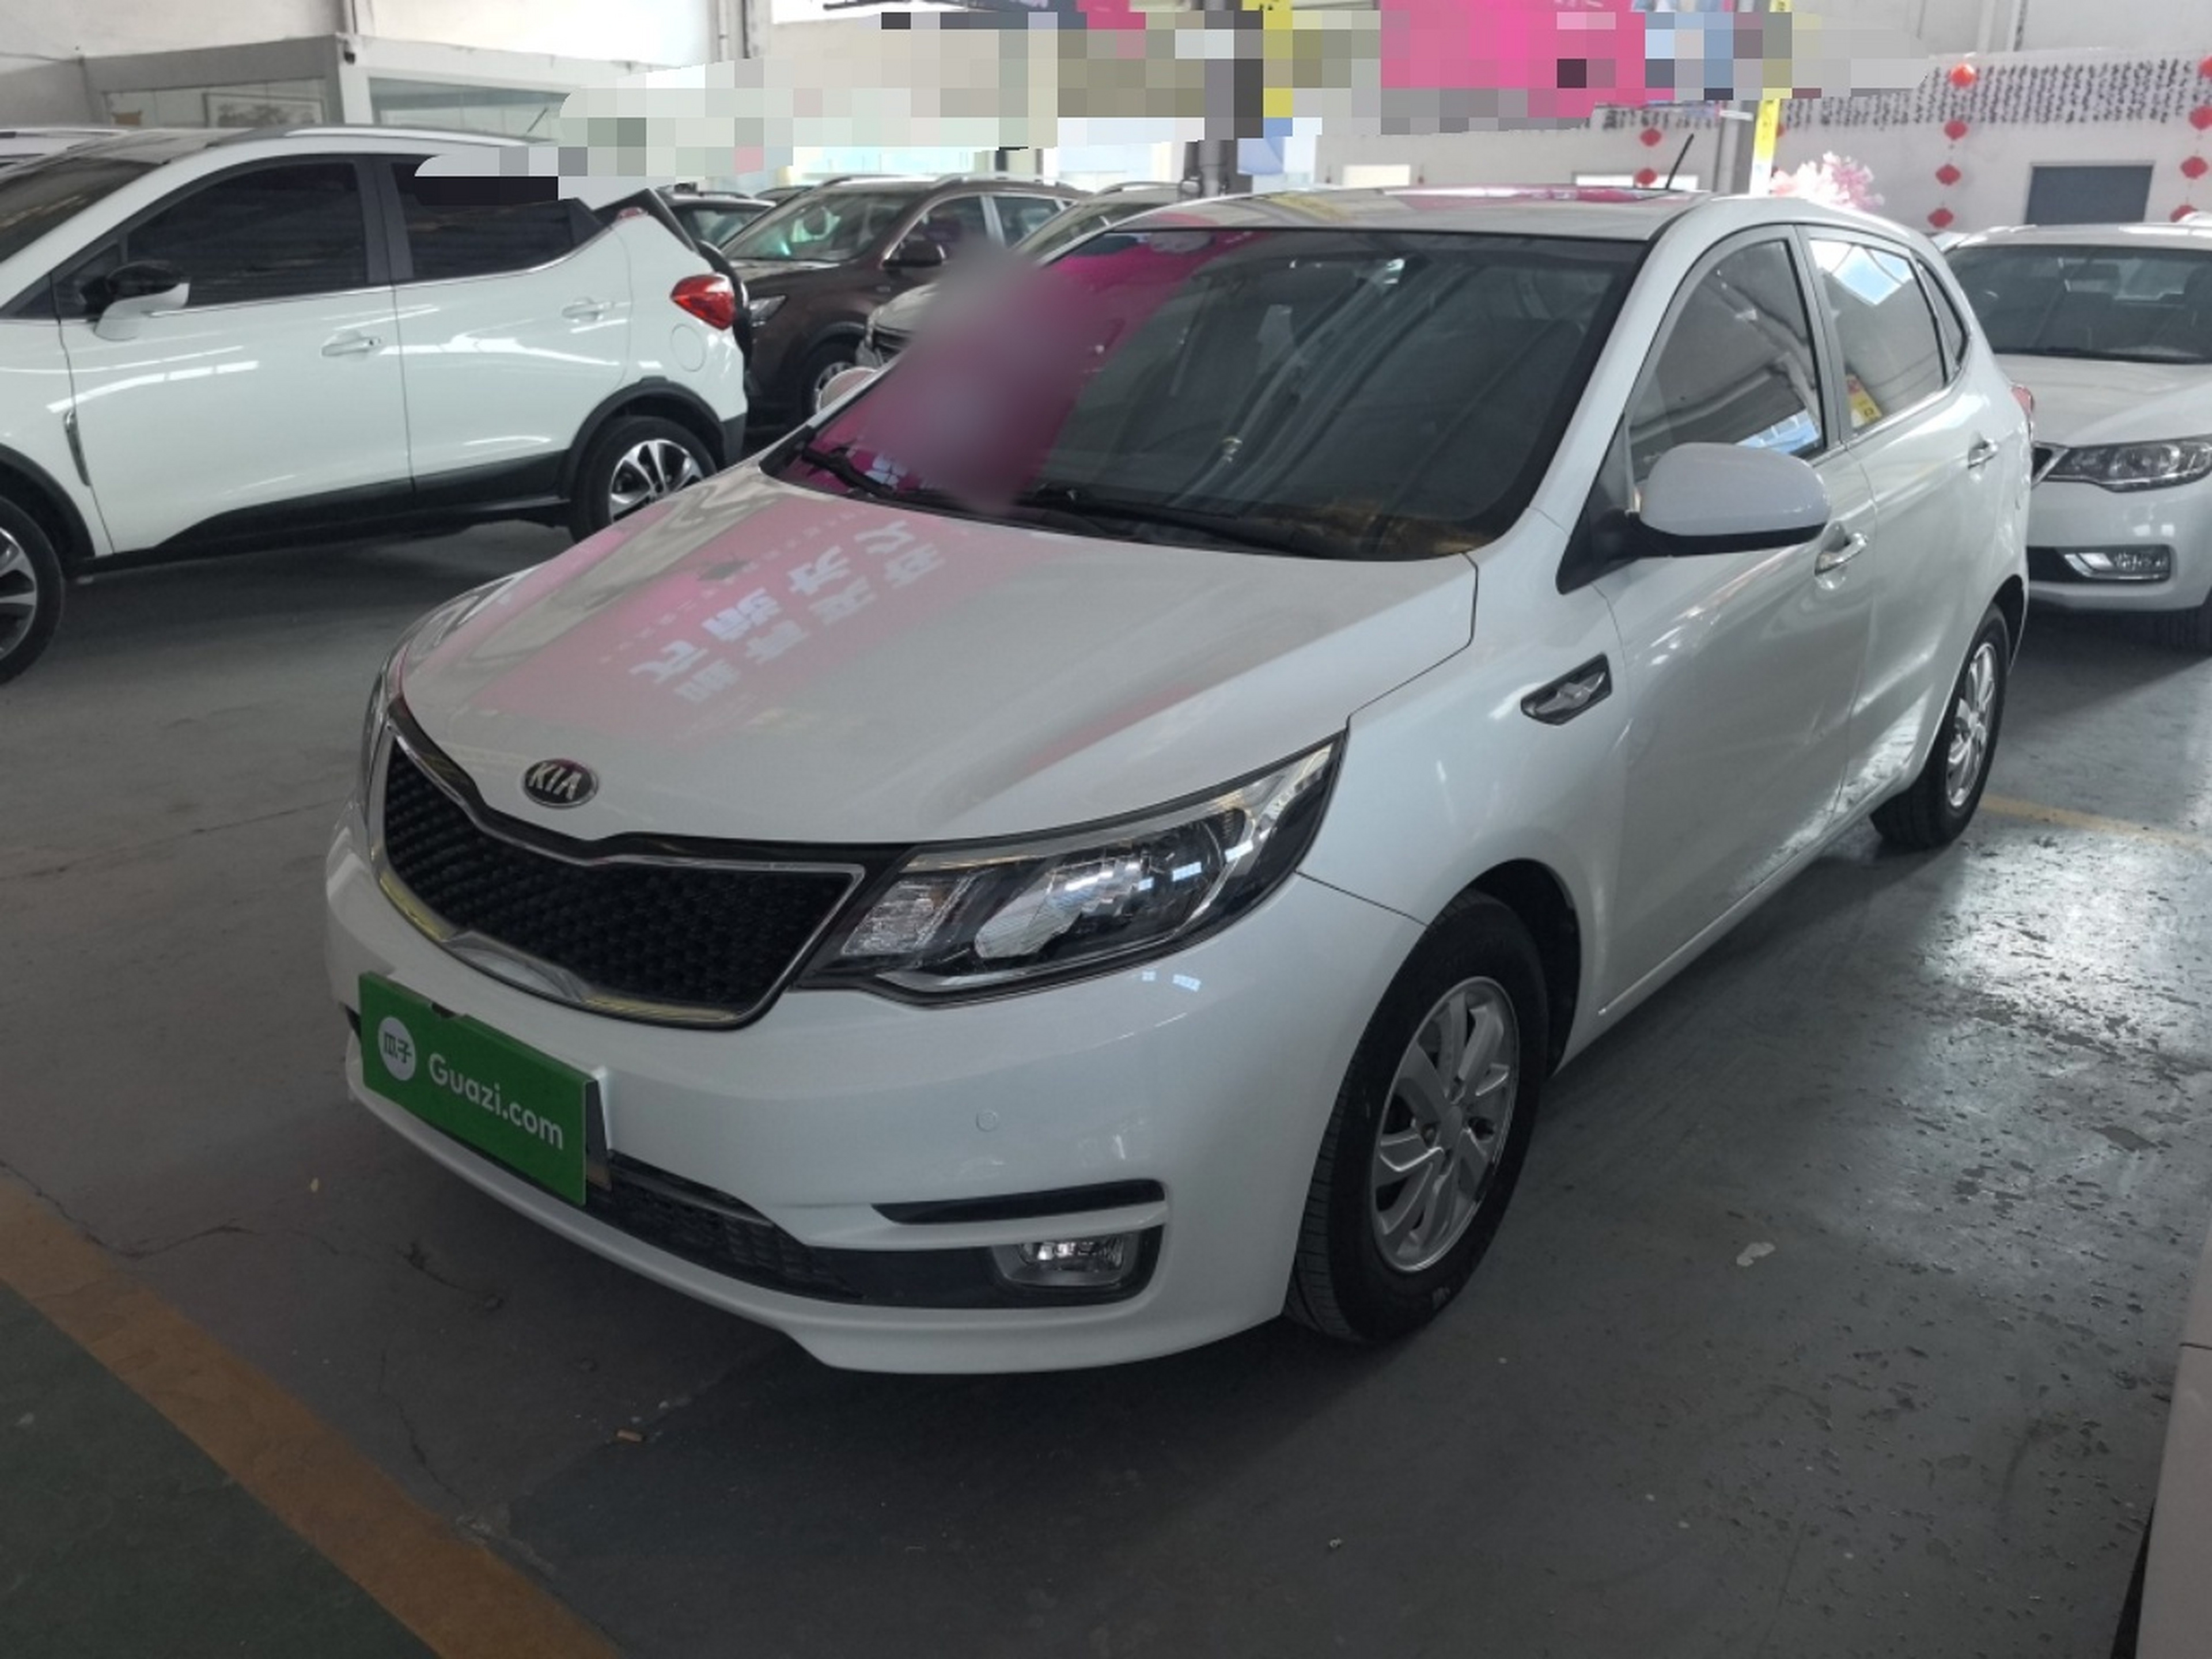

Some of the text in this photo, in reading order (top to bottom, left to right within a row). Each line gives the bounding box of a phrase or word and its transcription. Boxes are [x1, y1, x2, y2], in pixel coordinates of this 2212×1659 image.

[528, 762, 582, 800] KIA
[382, 1032, 412, 1064] 瓜子
[429, 1053, 563, 1150] Guazi.com
